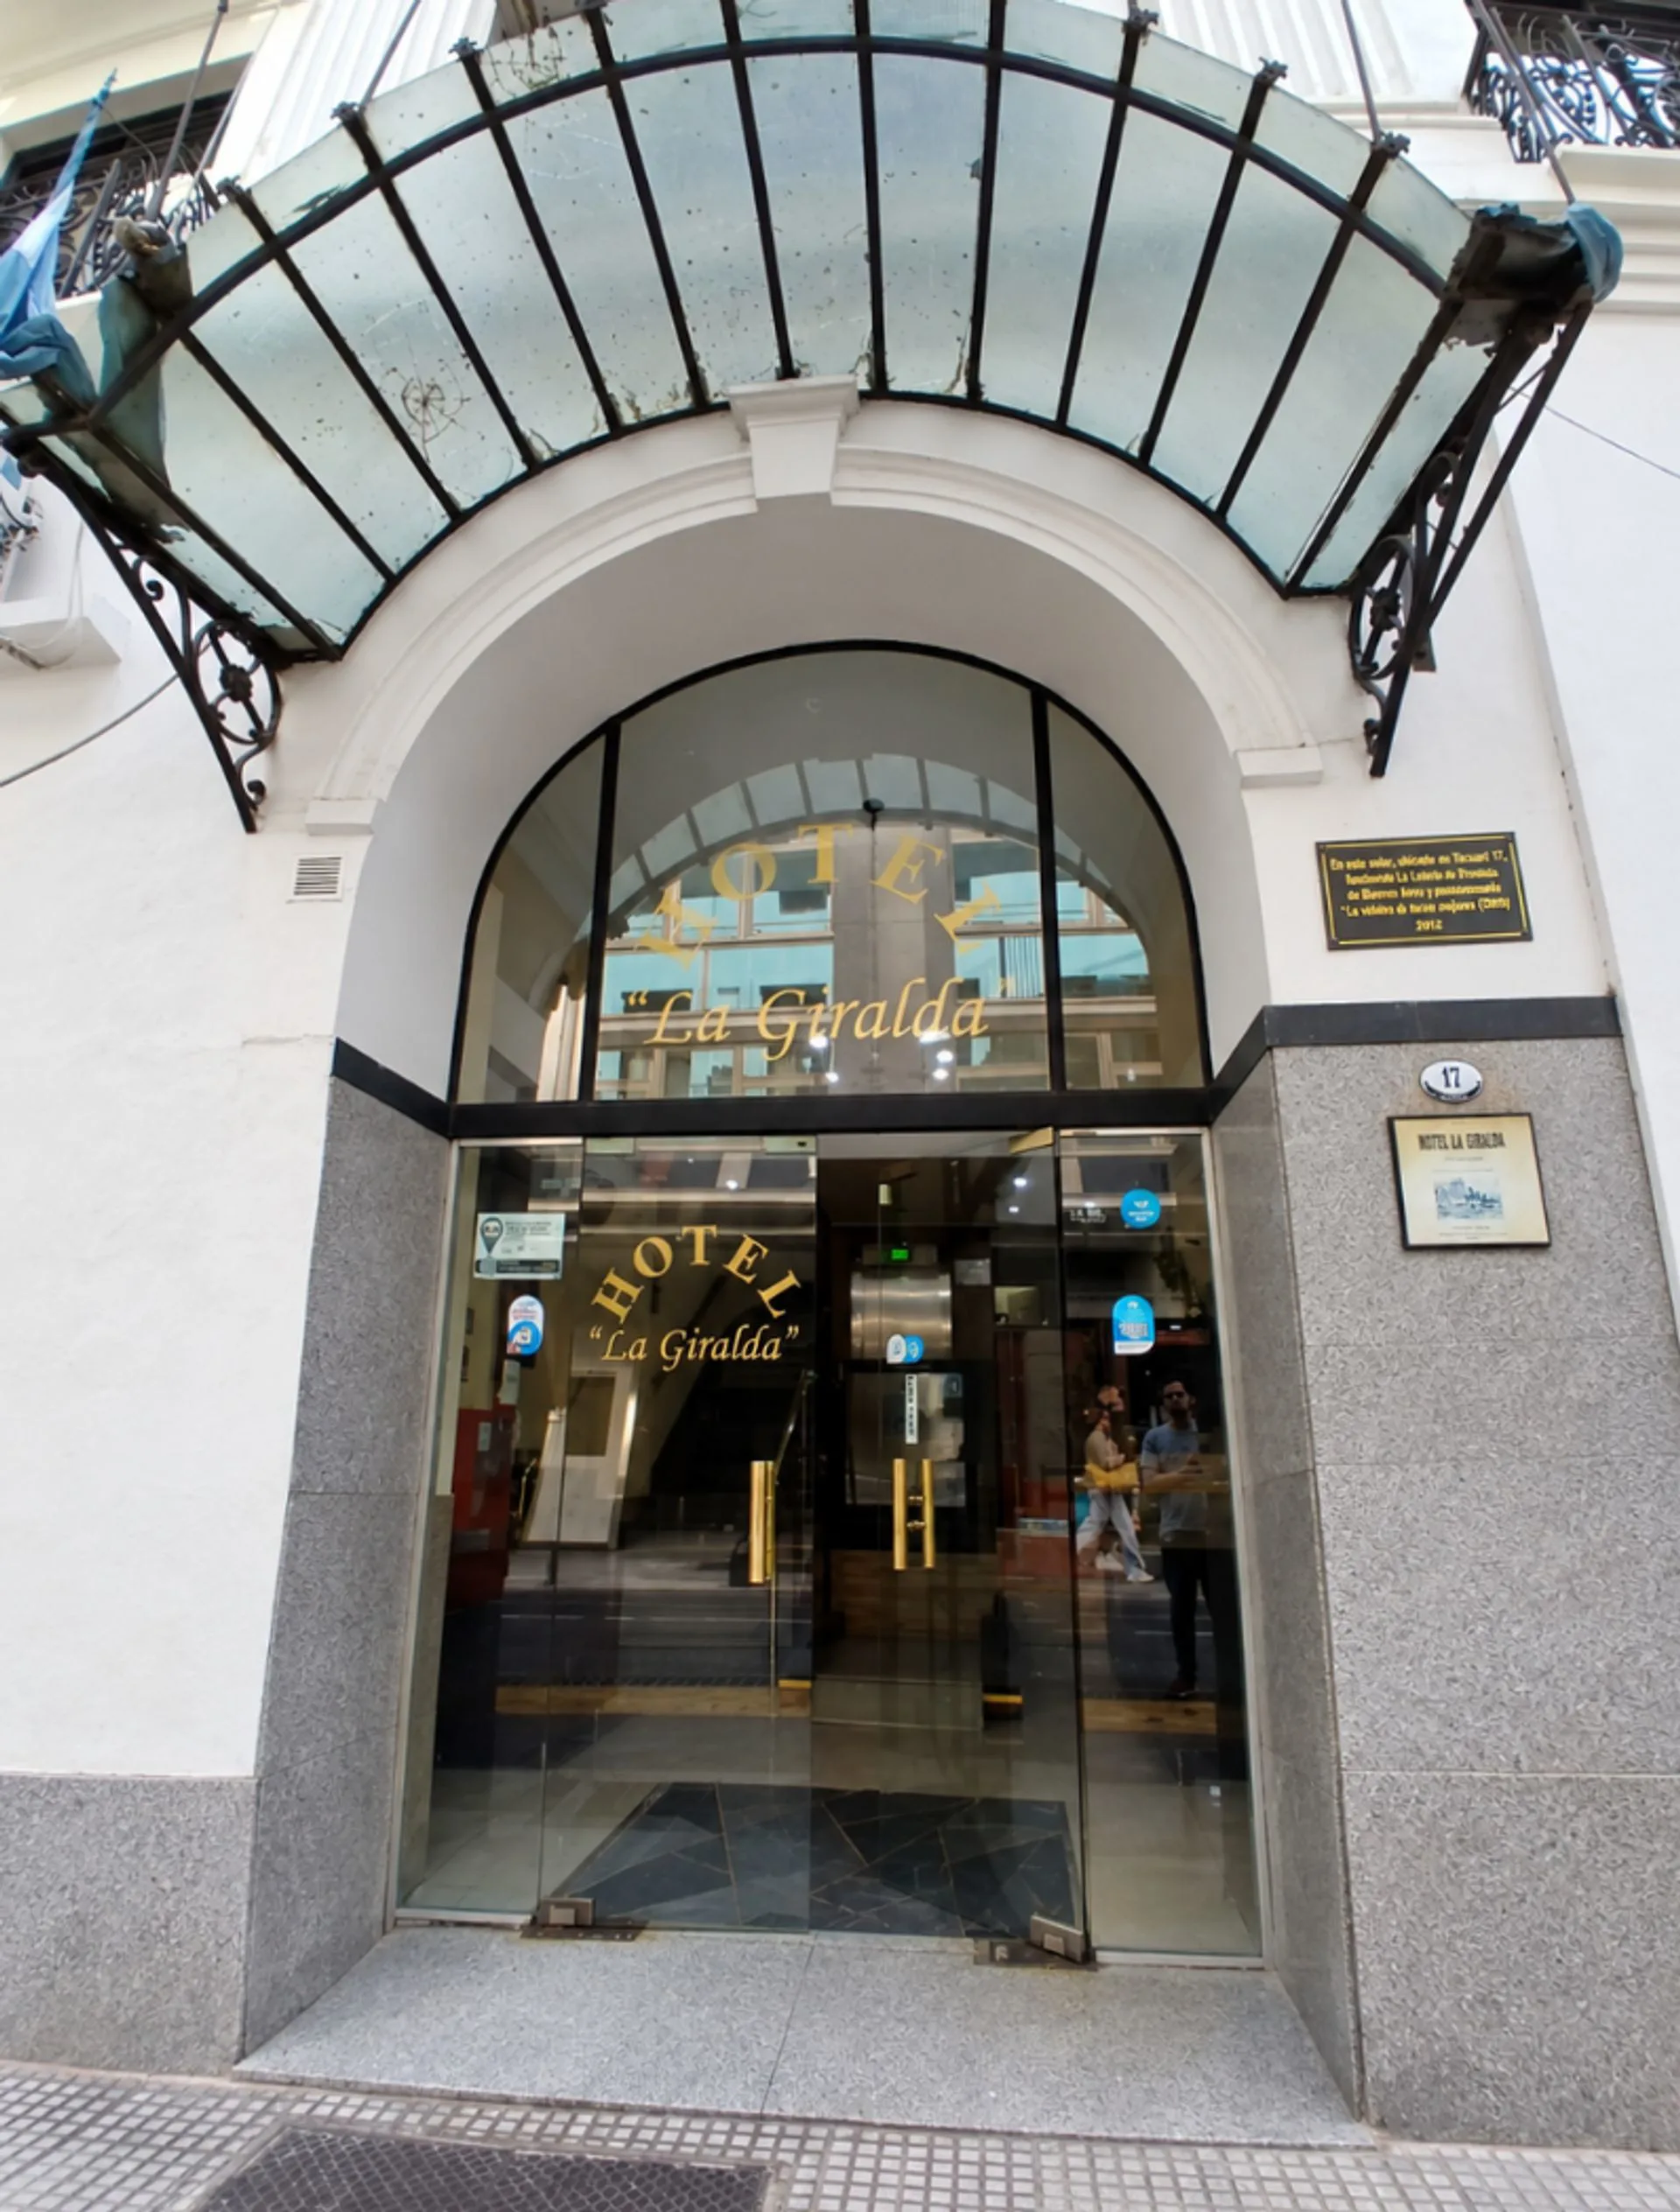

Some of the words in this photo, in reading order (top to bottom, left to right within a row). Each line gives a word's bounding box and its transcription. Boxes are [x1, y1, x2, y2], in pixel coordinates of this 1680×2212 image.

[637, 822, 1003, 971] HOTEL
[1442, 1067, 1460, 1088] 17
[1450, 1133, 1464, 1150] LA
[591, 1225, 802, 1324] HOTEL
